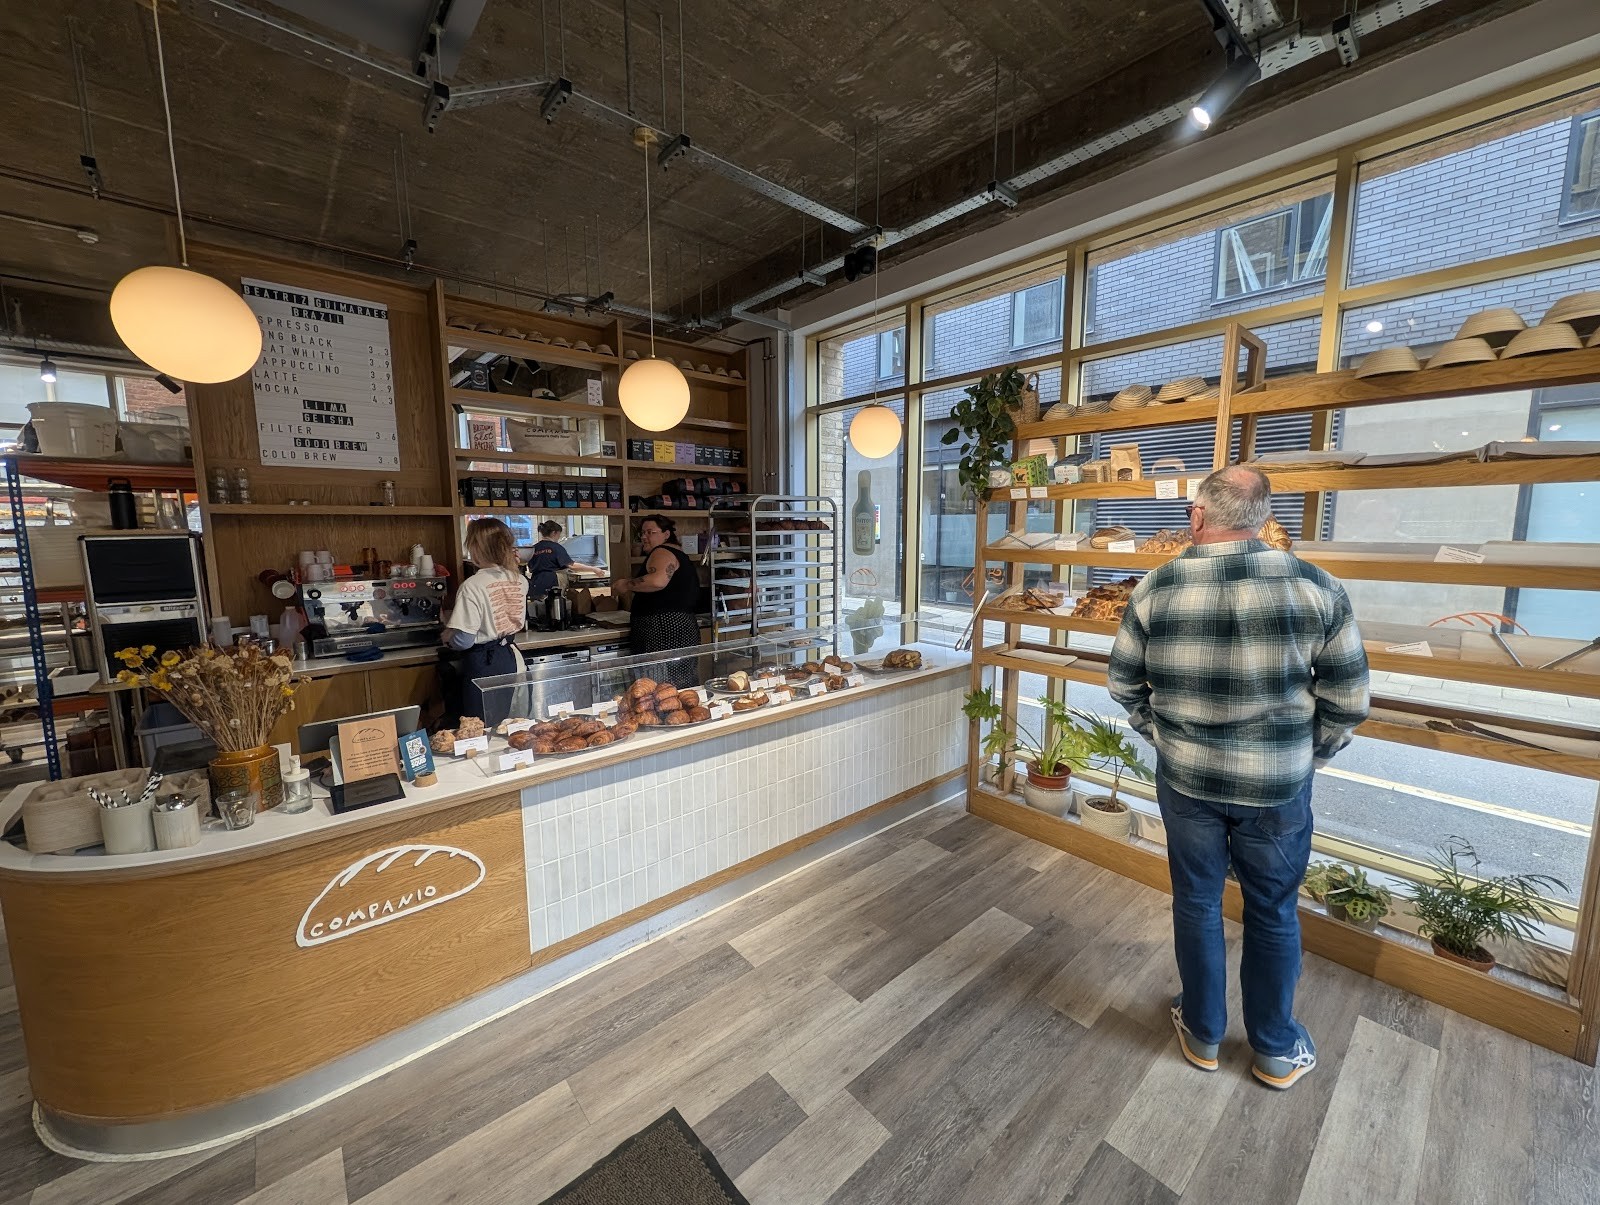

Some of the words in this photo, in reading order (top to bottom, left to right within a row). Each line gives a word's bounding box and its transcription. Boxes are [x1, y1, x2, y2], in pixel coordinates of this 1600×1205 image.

[243, 285, 307, 305] BEATRIZ
[315, 299, 387, 319] GUIMARAES
[293, 307, 342, 324] BRAZIL
[257, 315, 319, 333] SPRESSO
[291, 333, 333, 348] BLACK
[291, 347, 334, 361] WHITE
[262, 356, 340, 375] APPUCCINO
[254, 369, 298, 382] LATTE
[254, 382, 299, 395] MOCHA
[304, 400, 345, 413] LIIMA
[303, 413, 354, 426] GEISHA
[260, 423, 312, 434] FILTER
[295, 438, 328, 448] GOOD
[335, 440, 367, 451] BREW
[262, 449, 296, 459] COLD
[304, 452, 337, 461] BREW
[310, 885, 437, 937] COMPANIO
